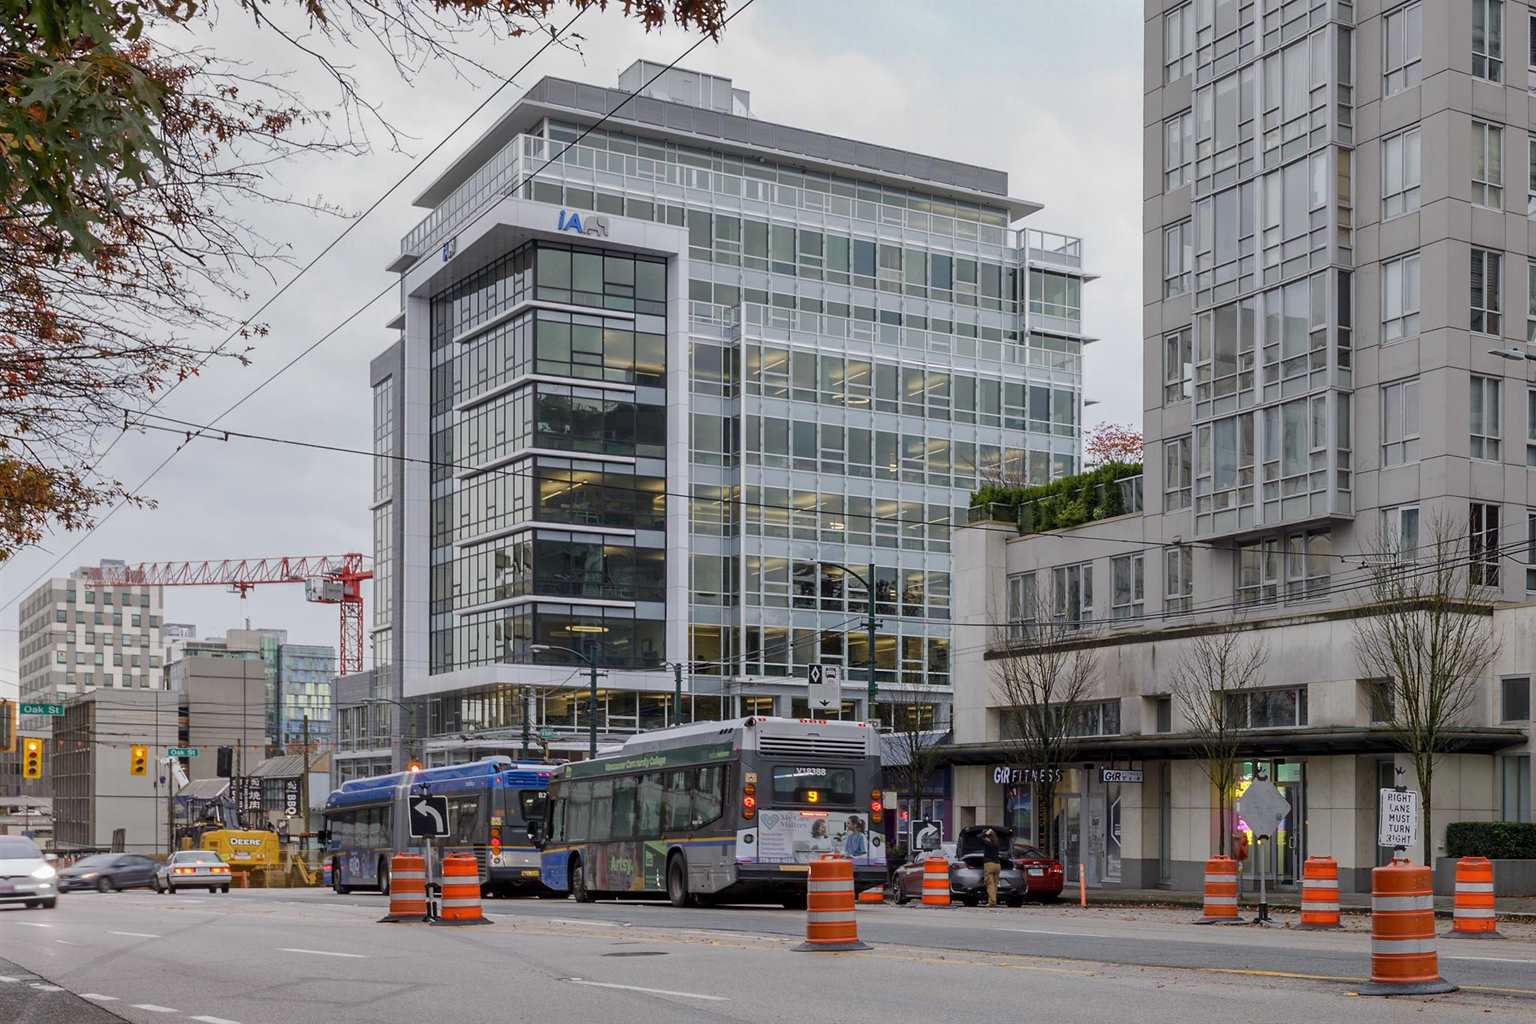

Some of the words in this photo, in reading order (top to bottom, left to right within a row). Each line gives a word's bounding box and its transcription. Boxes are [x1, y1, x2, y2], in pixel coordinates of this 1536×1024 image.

[24, 706, 44, 714] Oak
[48, 706, 60, 714] St
[808, 791, 818, 802] 9
[1387, 793, 1411, 803] RIGHT
[285, 794, 297, 815] BBQ
[1390, 804, 1410, 814] LANE
[1389, 814, 1410, 824] MUST
[1389, 824, 1410, 834] TURN
[1386, 833, 1411, 844] RIGHT
